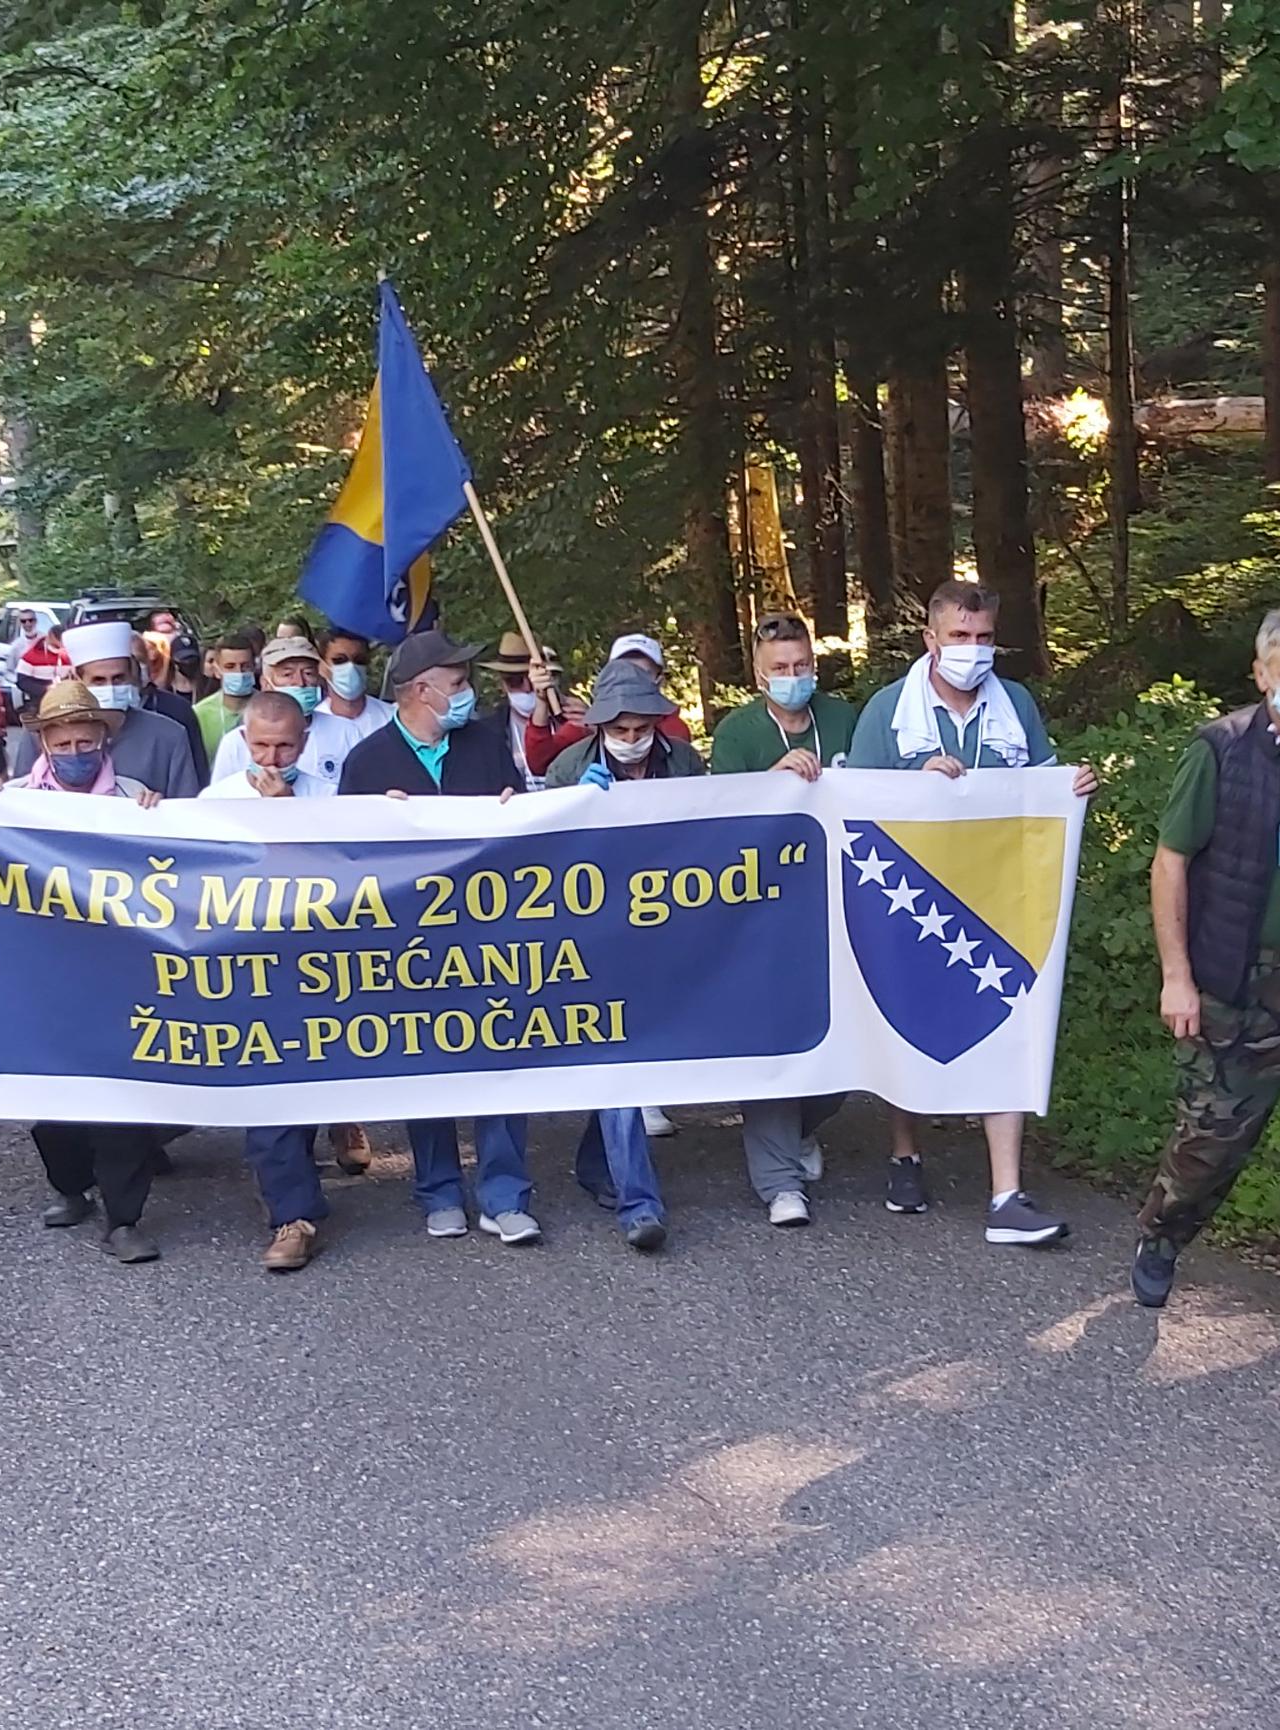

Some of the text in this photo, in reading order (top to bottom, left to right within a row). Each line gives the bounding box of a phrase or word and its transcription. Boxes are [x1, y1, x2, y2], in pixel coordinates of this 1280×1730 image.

[194, 874, 397, 932] MIRA
[414, 862, 606, 928] 2020
[151, 936, 591, 1003] PUT SJEĆANJA
[129, 997, 628, 1067] ŽEPA-POTOČARI
